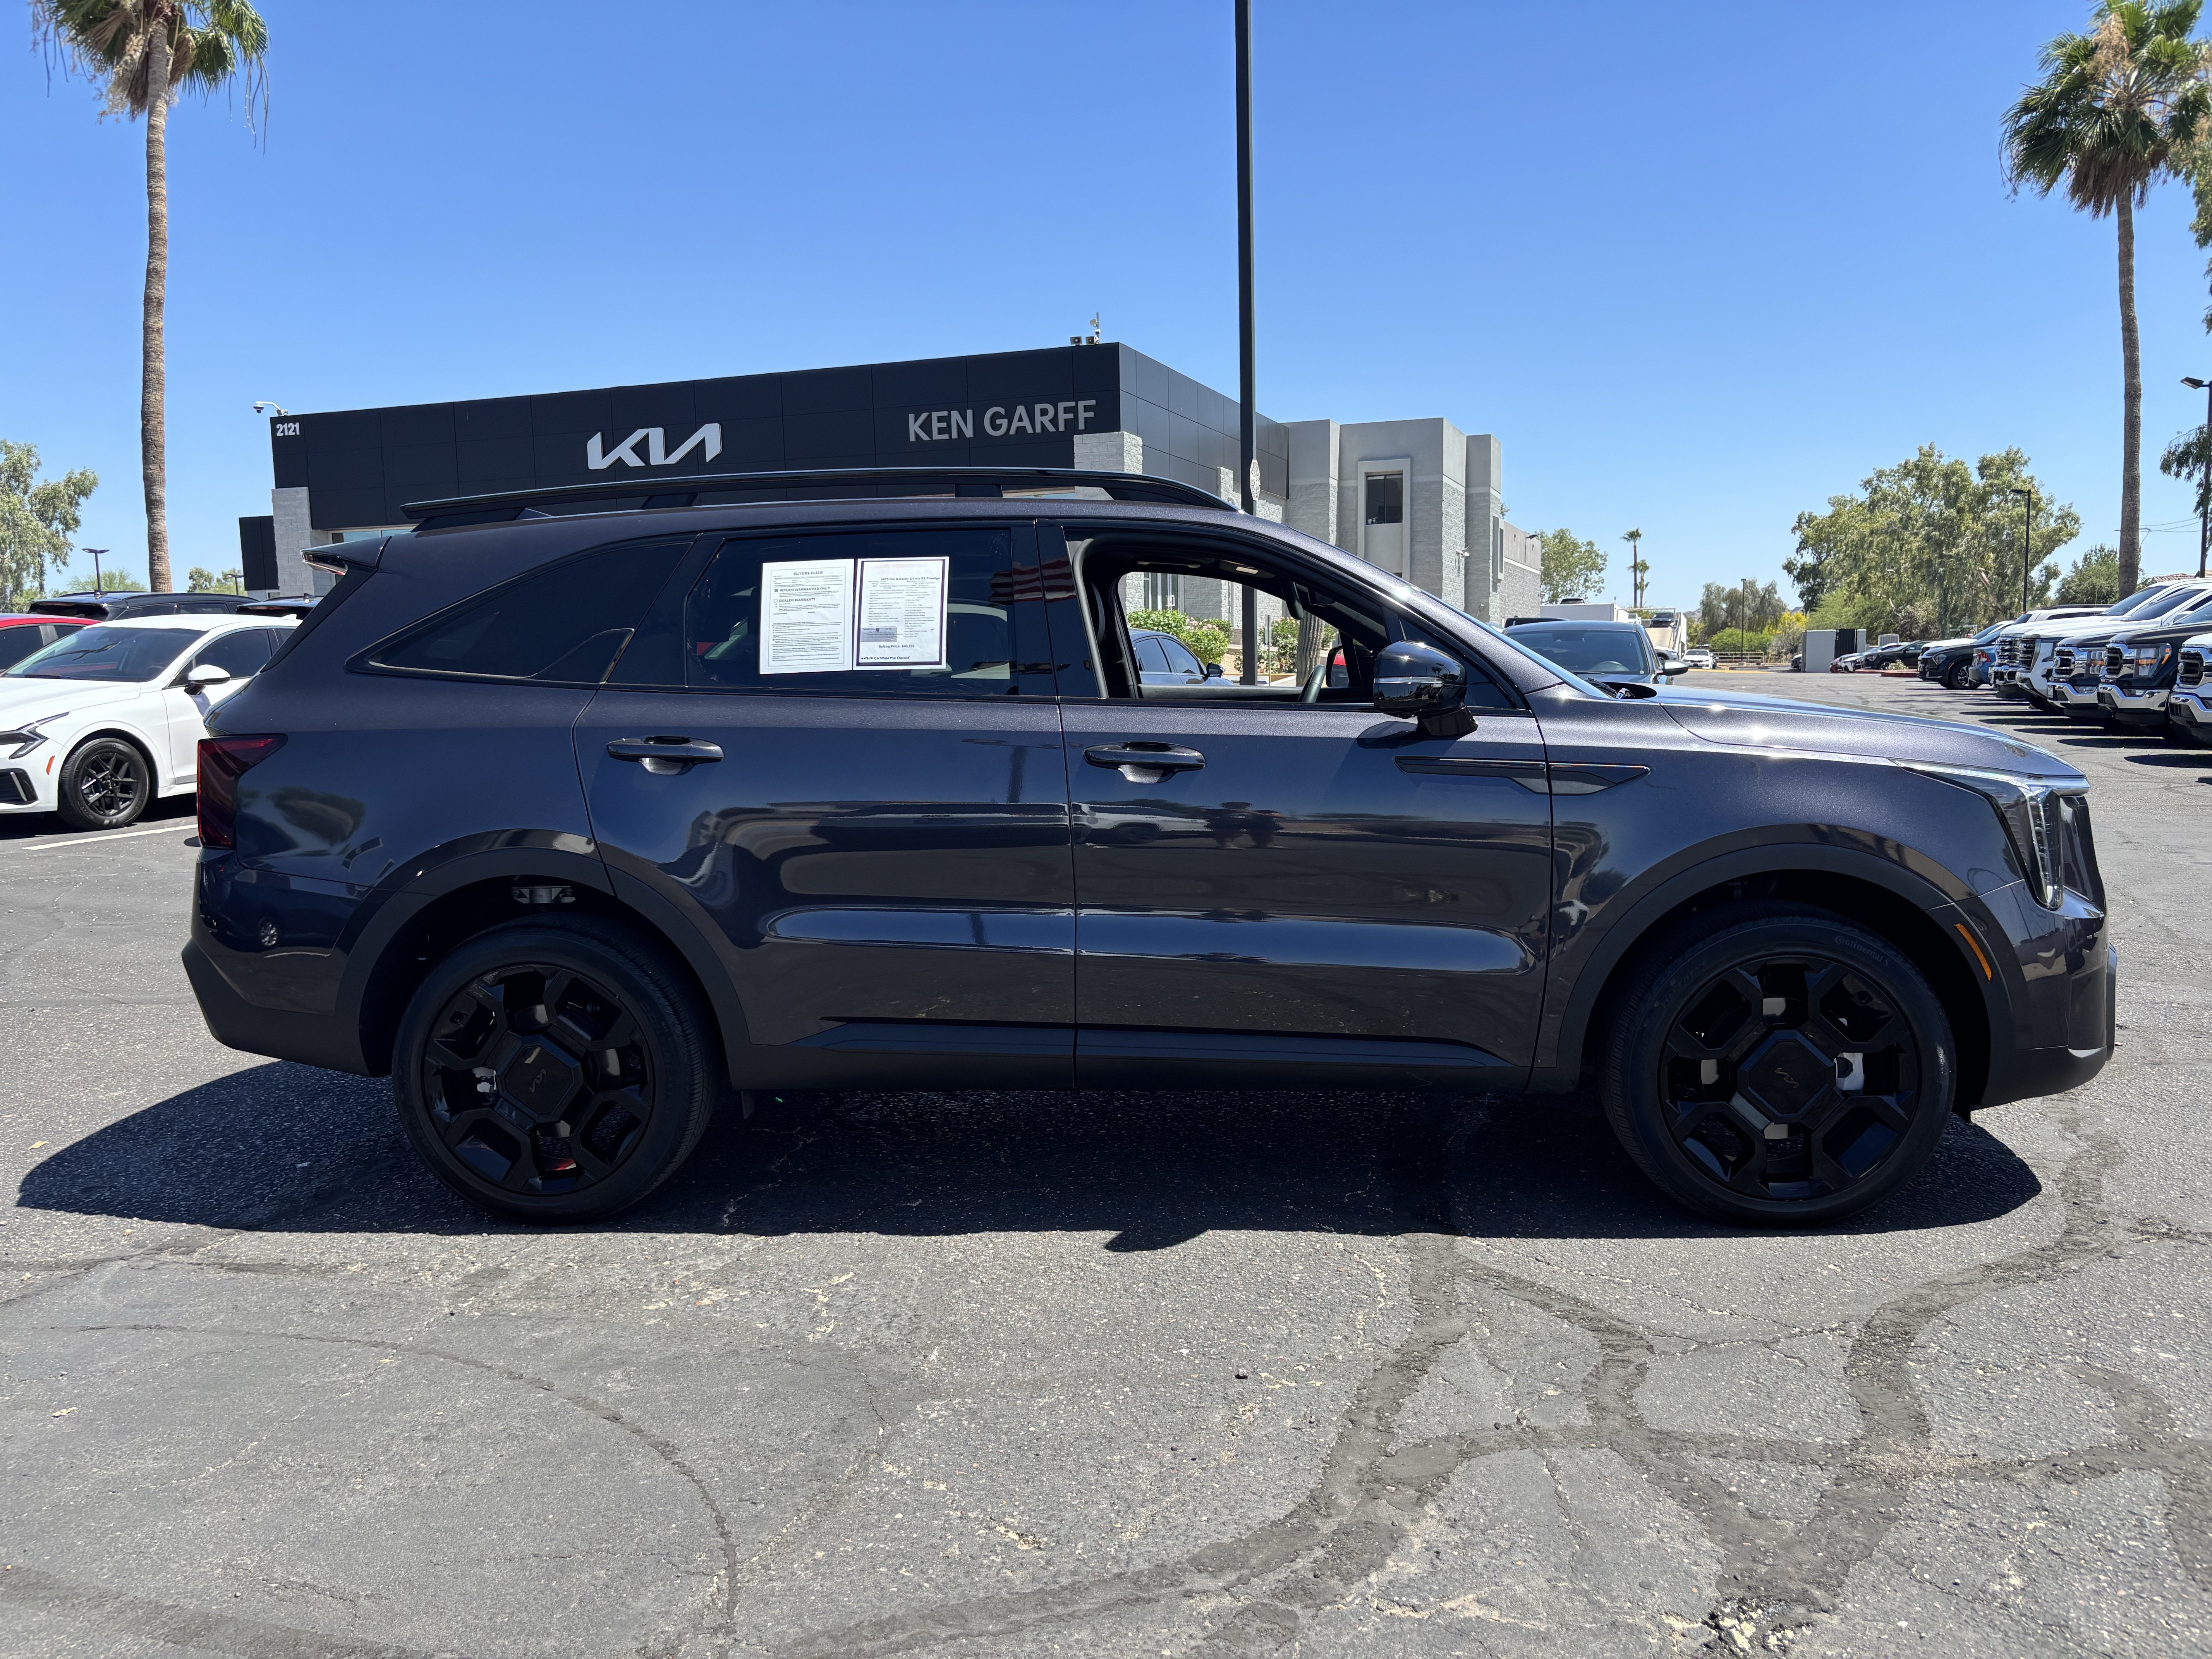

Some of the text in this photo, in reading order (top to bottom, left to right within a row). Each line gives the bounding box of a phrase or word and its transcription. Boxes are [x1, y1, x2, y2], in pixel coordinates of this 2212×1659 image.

[276, 422, 300, 436] 2121
[908, 400, 1096, 441] KEN GARFF
[587, 423, 722, 470] KIA
[1834, 935, 1884, 963] Continental
